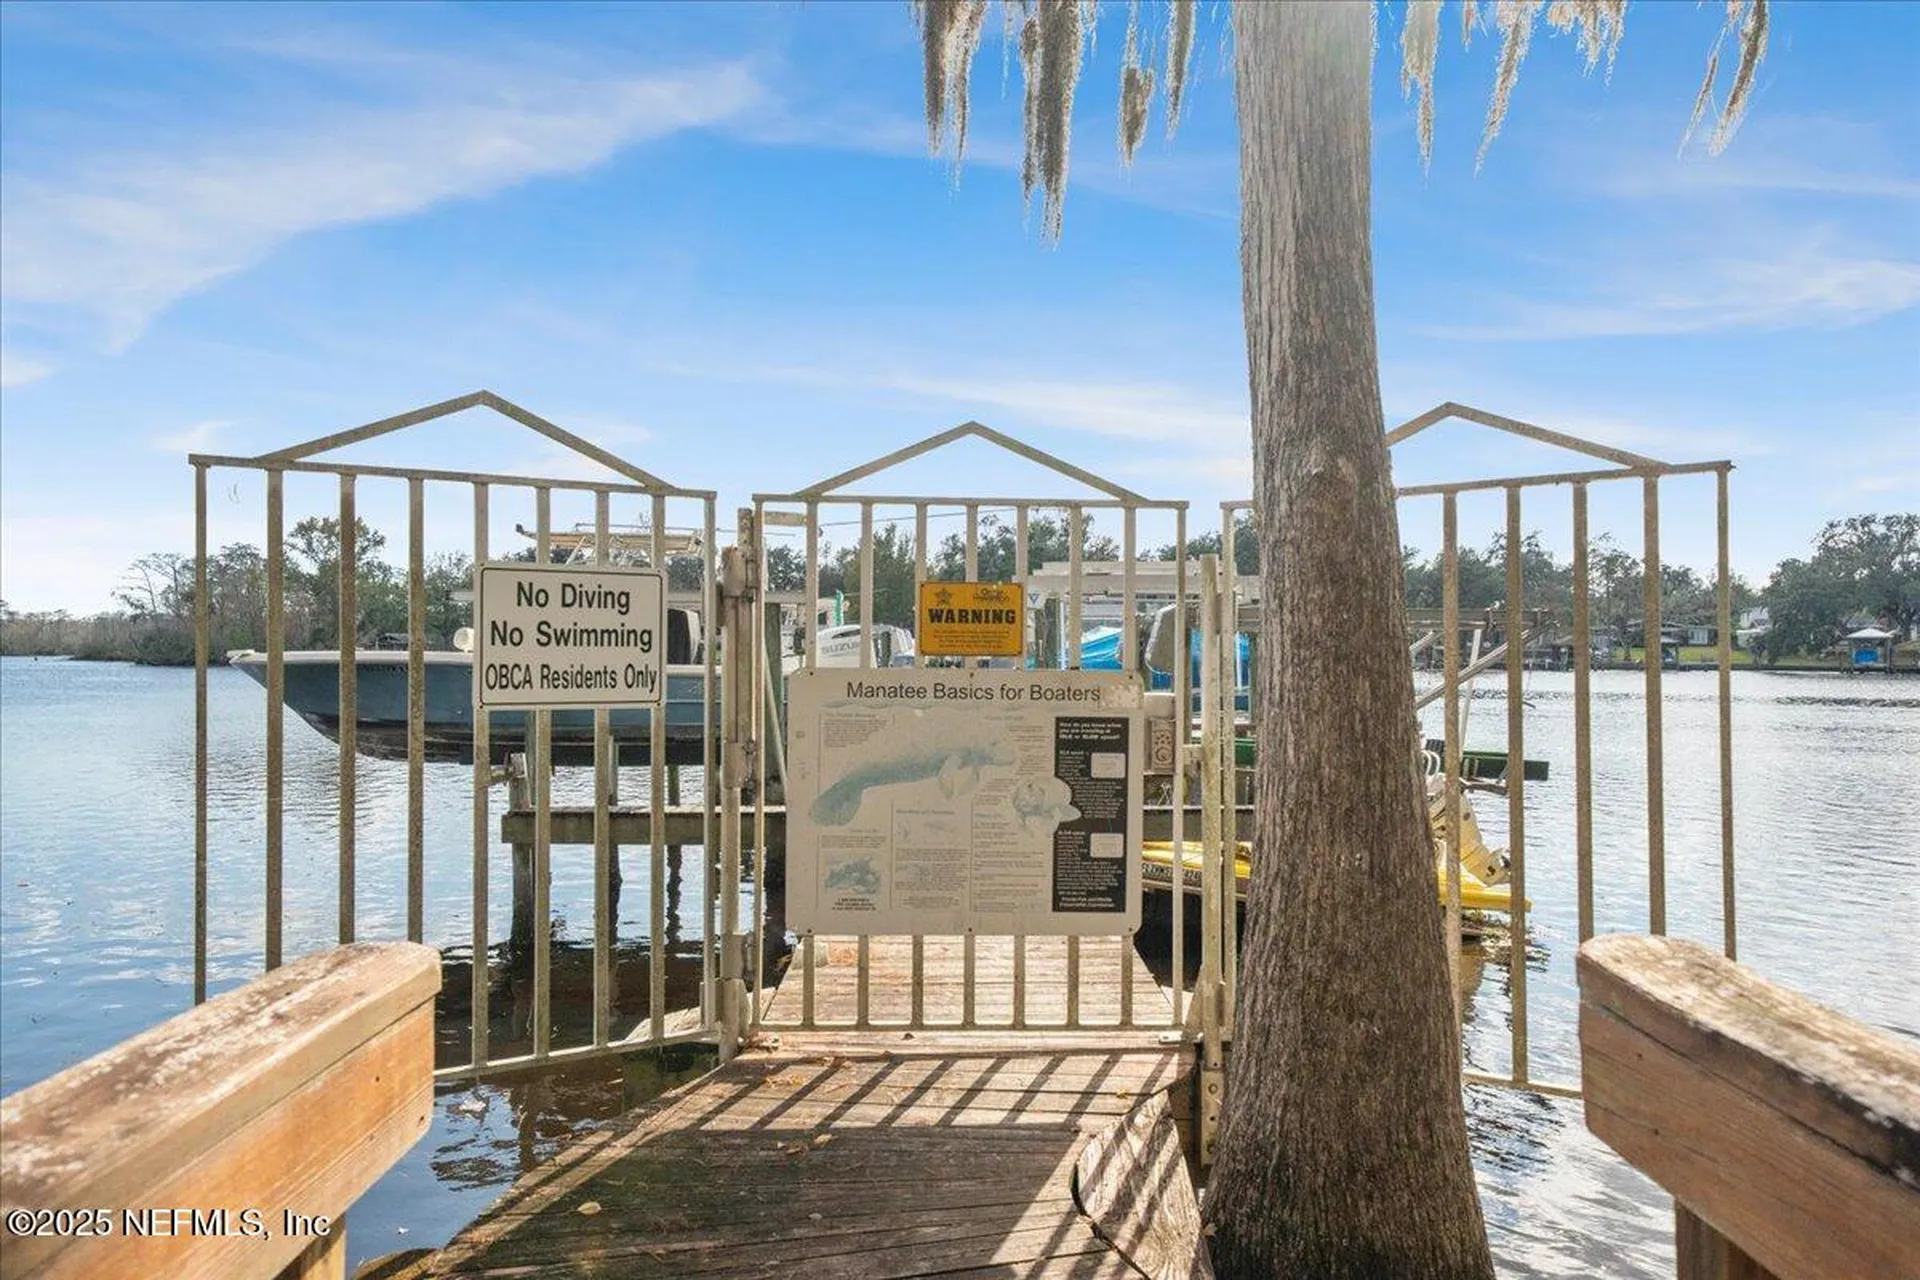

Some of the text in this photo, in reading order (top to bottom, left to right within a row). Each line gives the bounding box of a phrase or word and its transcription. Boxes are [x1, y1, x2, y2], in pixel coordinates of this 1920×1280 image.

[516, 581, 631, 615] No Diving
[928, 608, 1016, 624] WARNING
[490, 620, 652, 653] No Swimming
[485, 663, 657, 693] OBCA Residents Only
[846, 682, 1101, 701] Manatee Basics for Boaters
